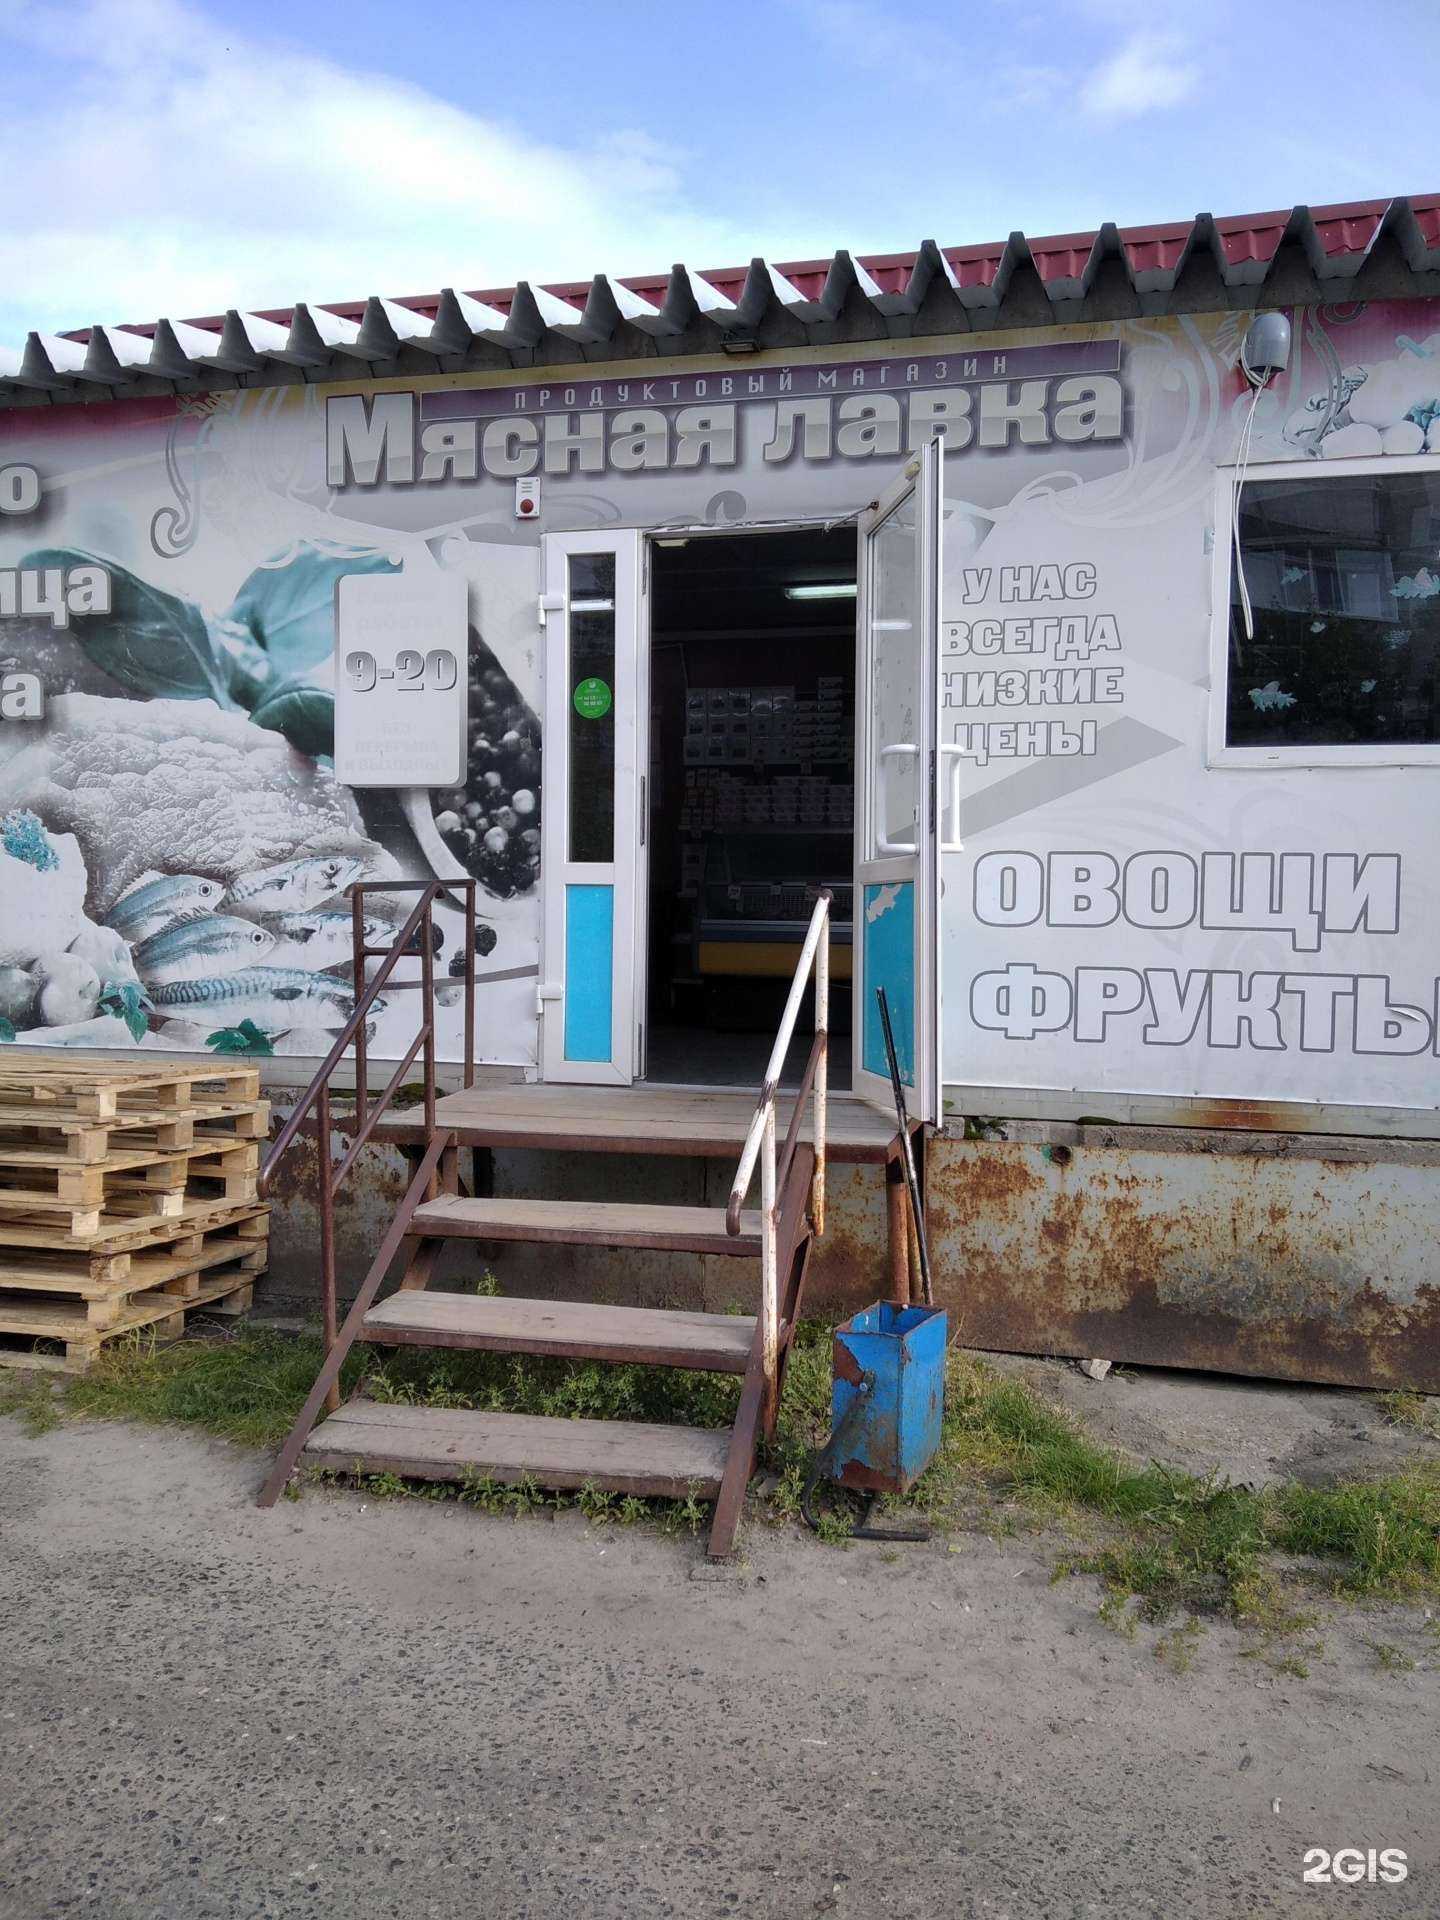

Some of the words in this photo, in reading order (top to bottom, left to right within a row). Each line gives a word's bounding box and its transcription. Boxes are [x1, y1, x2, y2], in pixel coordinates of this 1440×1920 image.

[514, 369, 793, 409] ПРОДУКТОВЫЙ
[817, 355, 1007, 389] МАГАЗИН
[327, 391, 738, 487] Мясная
[763, 375, 1124, 463] лавка
[962, 567, 993, 604] У
[999, 562, 1098, 603] НАС
[942, 614, 1122, 661] ВСЕГДА
[345, 649, 457, 692] 9-20
[942, 667, 1125, 708] НИЗКИЕ
[954, 720, 1098, 766] ЦЕНЫ
[972, 849, 1401, 953] ОВОЩИ
[969, 962, 1440, 1058] ФРУКТЫ
